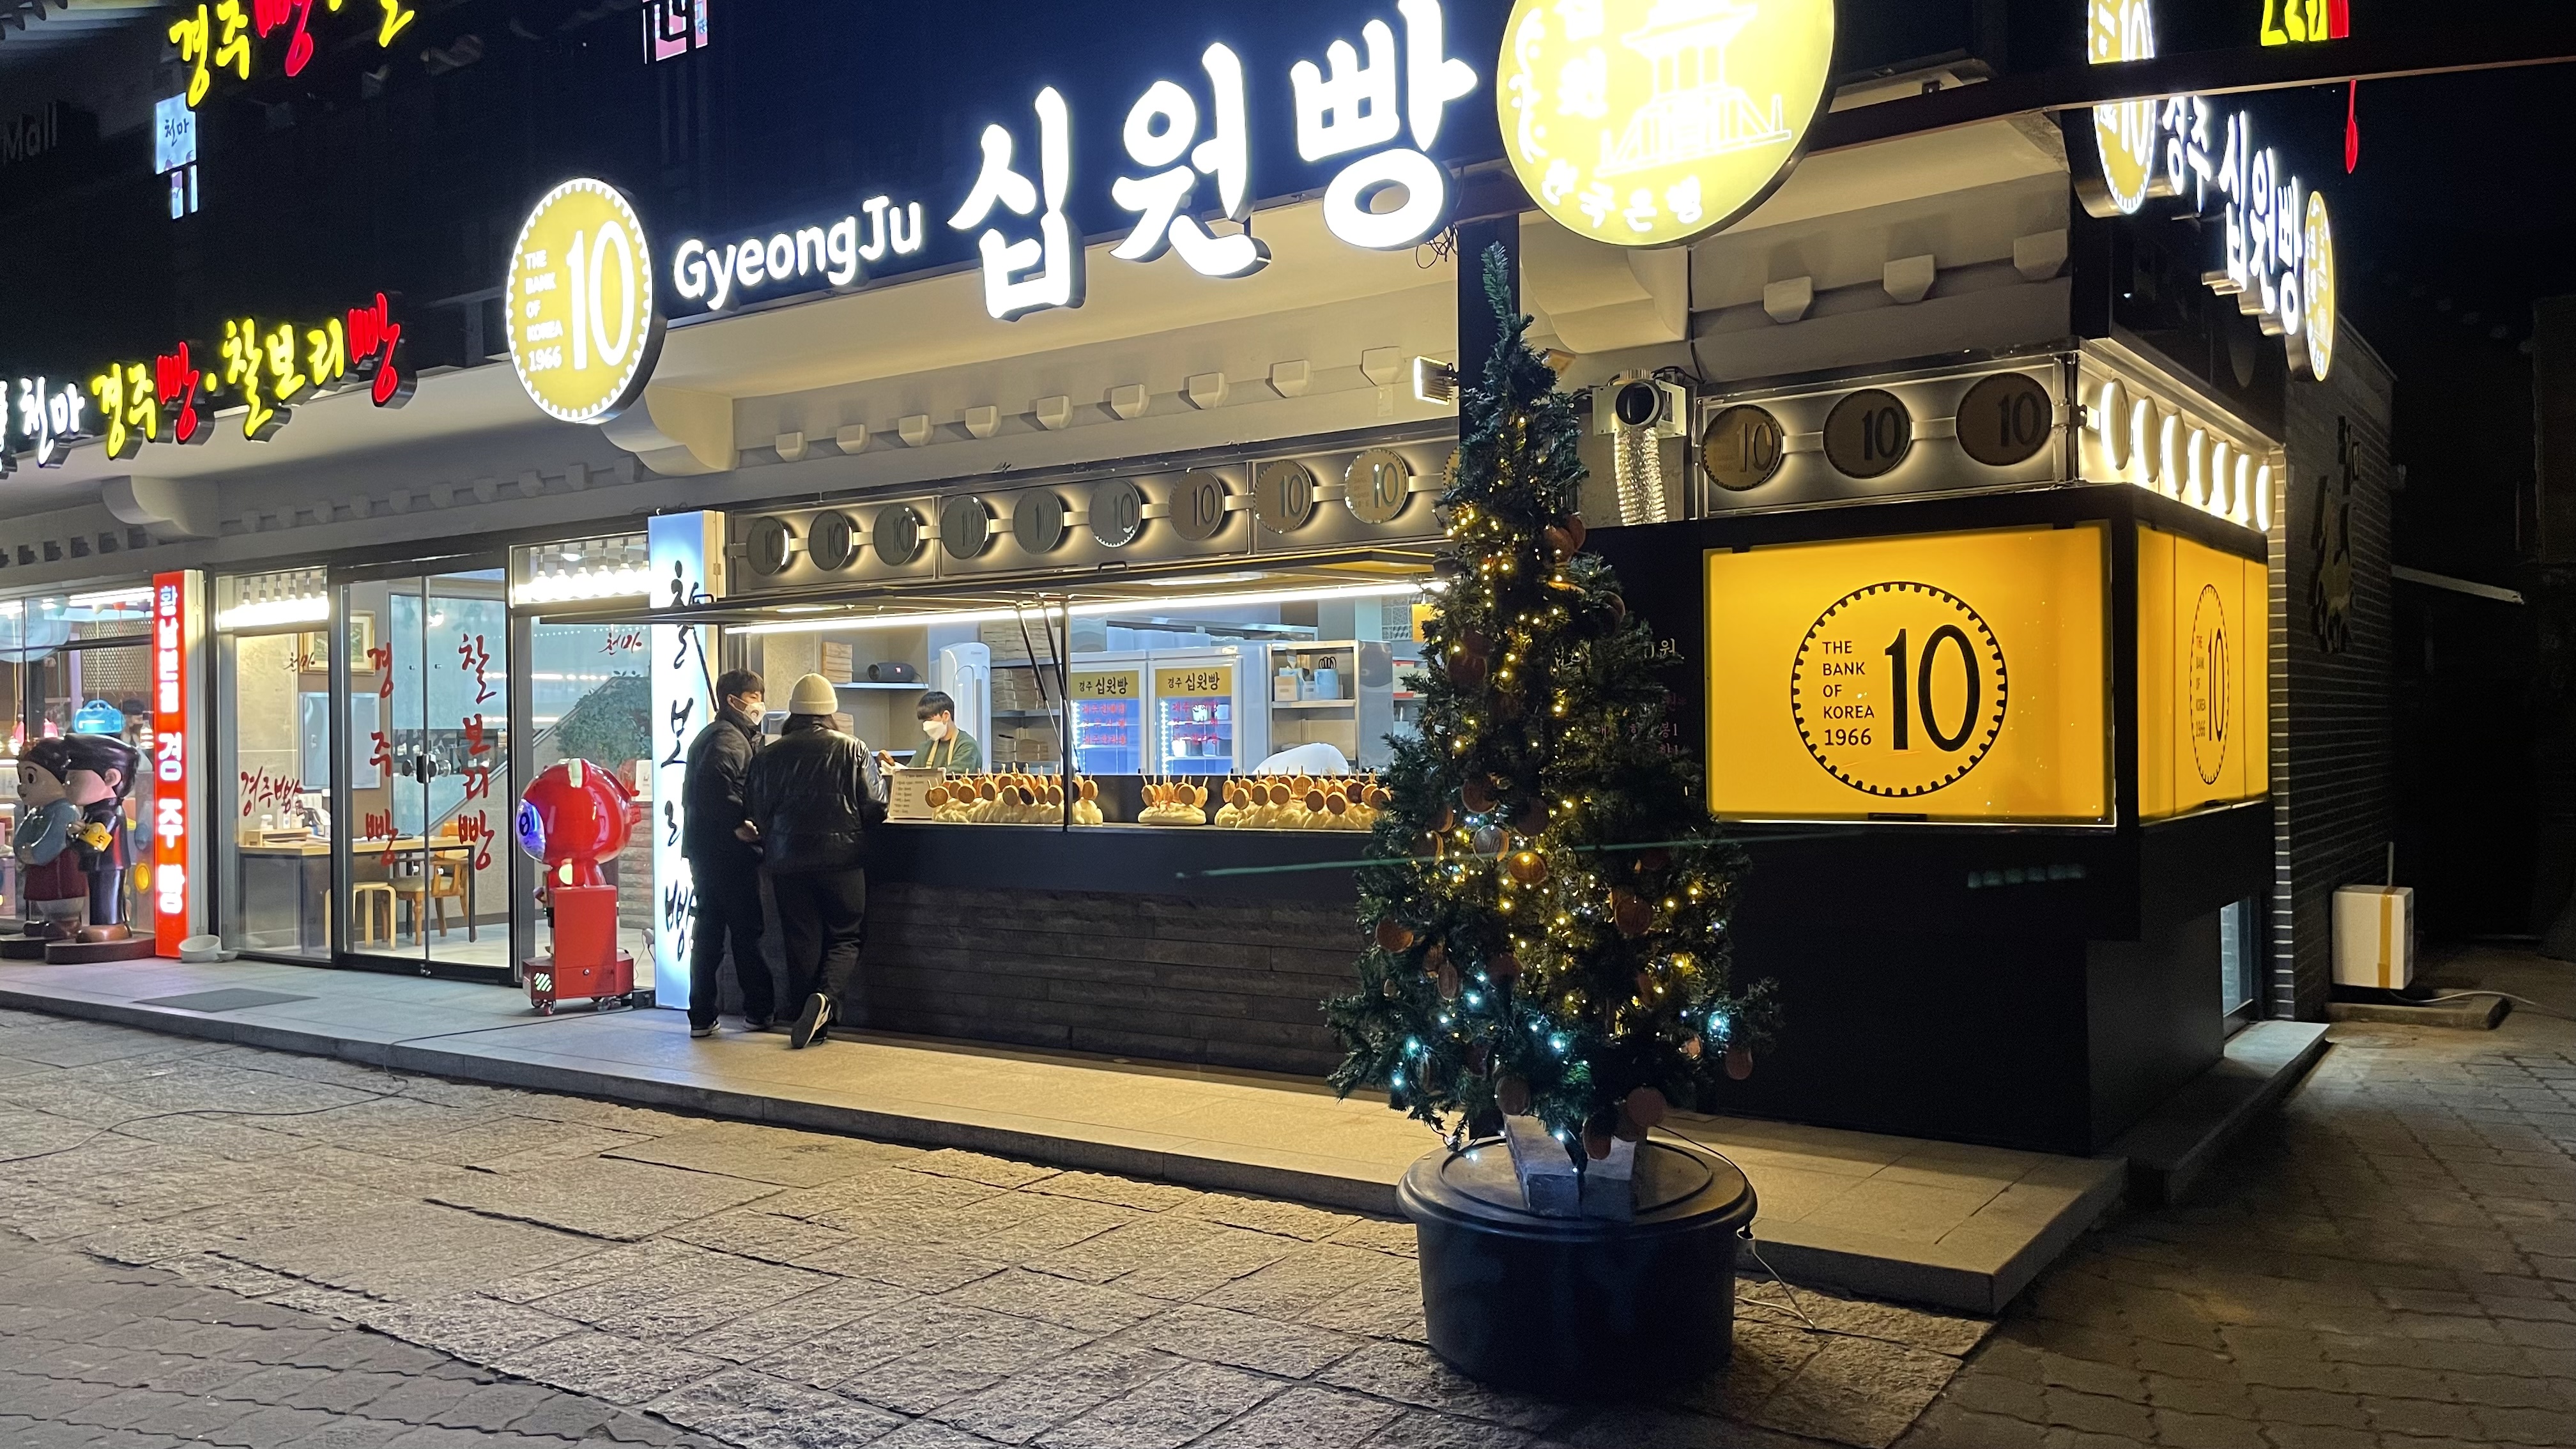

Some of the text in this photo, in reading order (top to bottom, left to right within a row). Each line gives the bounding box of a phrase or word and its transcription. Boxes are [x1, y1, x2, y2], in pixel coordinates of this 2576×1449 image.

[164, 118, 190, 147] 천마
[673, 0, 1478, 319] GyeongJu 십원빵
[2218, 110, 2303, 336] 십원빵
[526, 299, 541, 319] OF
[566, 220, 635, 371] 10
[528, 346, 562, 372] 1966
[1862, 405, 1899, 461] 10
[1999, 391, 2043, 447] 10
[1736, 420, 1774, 474] 10
[1192, 484, 1215, 526] 10
[1278, 473, 1305, 519] 10
[1372, 462, 1399, 509] 10
[1822, 641, 1853, 654] THE
[1822, 661, 1866, 676] BANK
[1078, 677, 1128, 695] 경주 십원빵
[1167, 671, 1220, 691] 경주 십원빵
[1822, 684, 1843, 698] OF
[1884, 624, 1981, 753] 10
[2208, 627, 2225, 742] 10
[1822, 705, 1875, 719] KOREA
[365, 643, 398, 867] 경주빵
[458, 634, 496, 871] 찰보리빵
[1823, 728, 1873, 746] 1966
[240, 765, 304, 816] 경주빵
